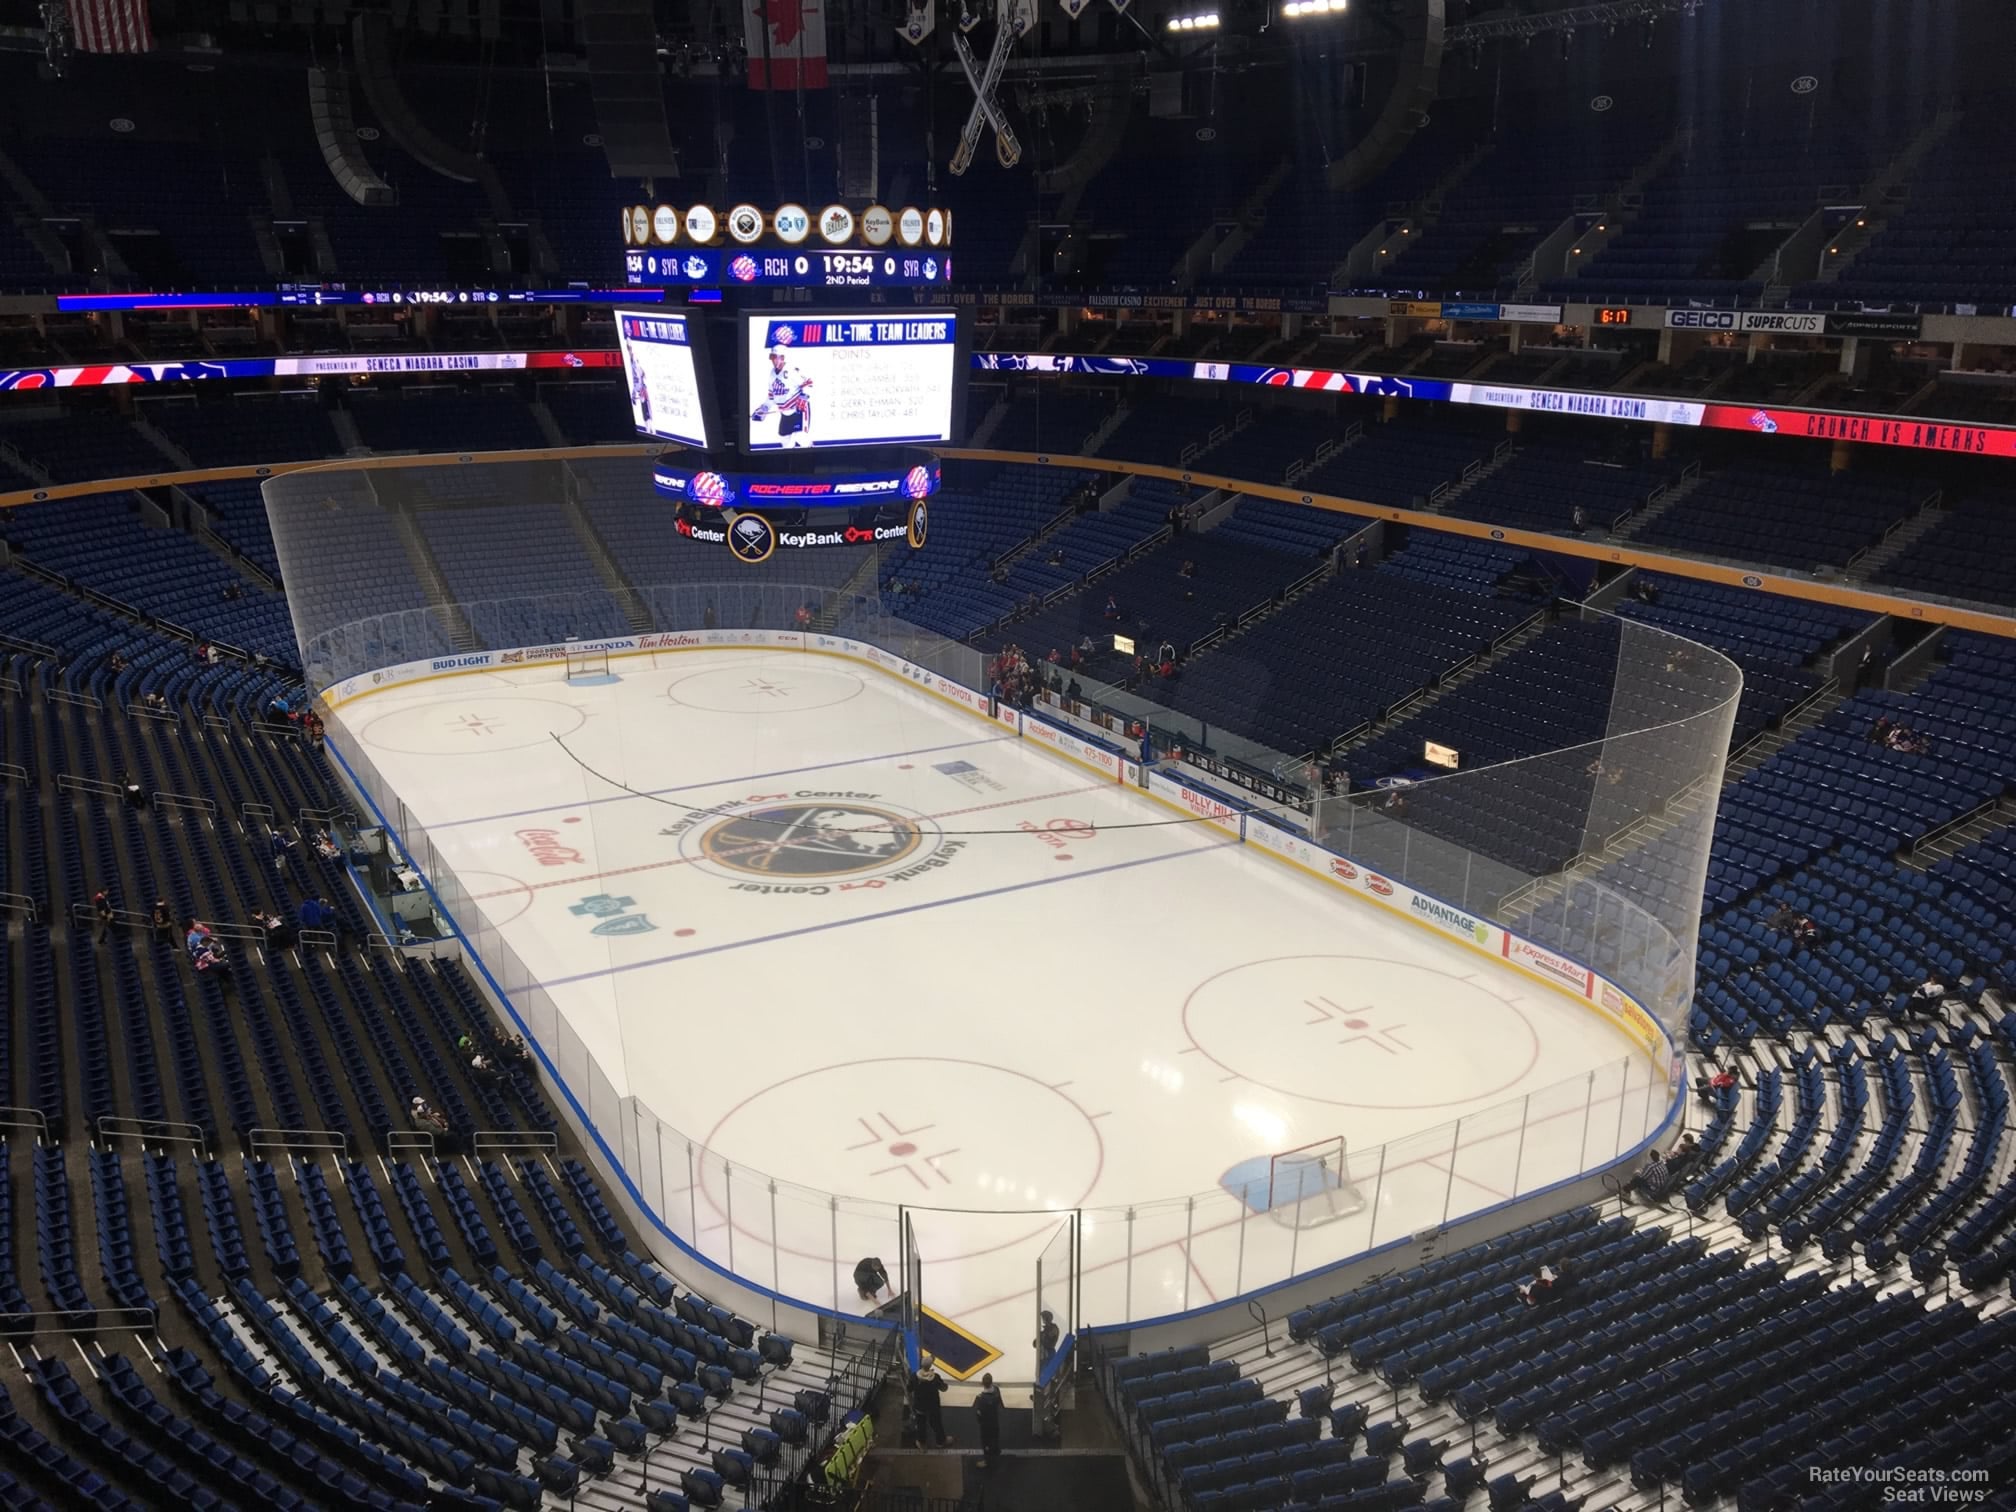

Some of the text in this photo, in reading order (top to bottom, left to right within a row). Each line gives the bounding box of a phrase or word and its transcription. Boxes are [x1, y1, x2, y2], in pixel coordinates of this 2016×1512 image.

[825, 218, 849, 236] Blue
[648, 256, 656, 274] 0
[662, 258, 678, 276] SYR
[764, 255, 920, 278] RCH 0 19:54 0 SYR
[826, 276, 870, 285] 2ND Period
[415, 291, 449, 304] 19:54
[1602, 310, 1627, 324] 6:17
[1671, 311, 1734, 327] GEICO
[1746, 315, 1817, 331] SUPERCUTS
[826, 322, 946, 343] ALL-TIME TEAM LEADERS
[366, 355, 479, 372] SENECA NIAGARA CASINO
[832, 349, 871, 361] POINTS
[1530, 391, 1565, 411] SENECA
[1567, 395, 1607, 415] NIAGARA
[1611, 399, 1646, 419] CASINO
[1807, 415, 1986, 453] CRUNCH VS AMERKS
[749, 479, 900, 495] ROCHESTER AMERICANS
[691, 525, 725, 543] Center
[779, 524, 908, 547] KeyBank Center
[638, 635, 700, 650] Tim Hortons
[432, 661, 456, 673] BUD
[457, 655, 491, 670] LIGHT
[947, 685, 973, 704] TOYOTA
[1083, 745, 1114, 767] 475-1100
[658, 789, 882, 837] KeyBank Center
[1181, 788, 1212, 811] BULLY
[1214, 801, 1236, 823] HILL
[728, 839, 968, 896] KeyBank Center
[1411, 895, 1475, 933] ADVANTAGE
[1521, 943, 1560, 970] Express
[1560, 962, 1587, 984] Mart
